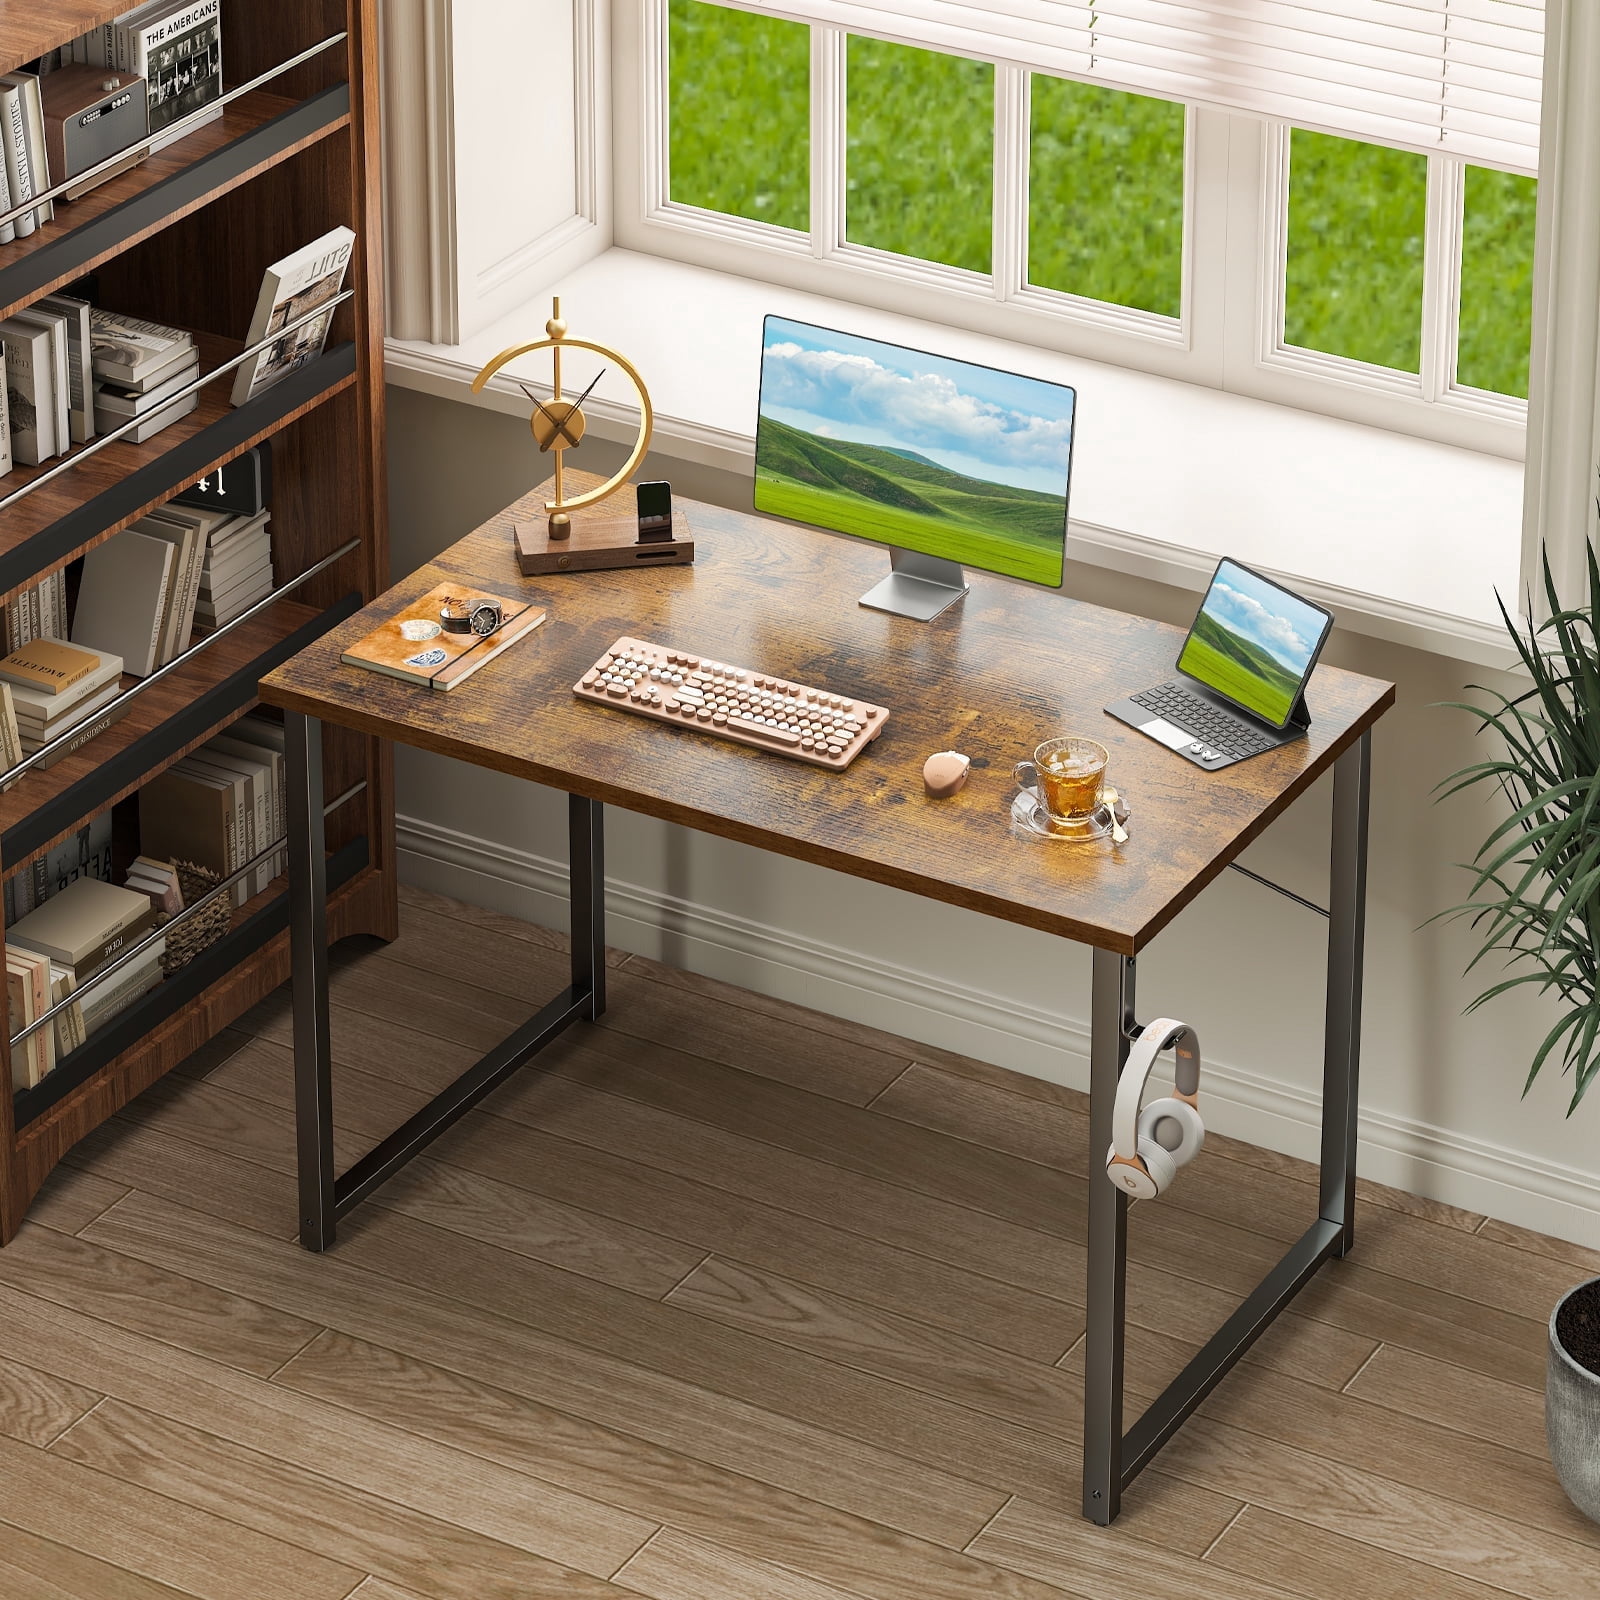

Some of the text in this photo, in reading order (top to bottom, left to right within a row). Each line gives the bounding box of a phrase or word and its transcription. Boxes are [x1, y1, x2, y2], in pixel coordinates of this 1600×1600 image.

[105, 24, 113, 48] pierre
[146, 0, 217, 46] THE AMERICANS
[11, 99, 25, 148] STORIES
[17, 150, 30, 185] STYLE
[80, 717, 112, 745] RESIDENCE
